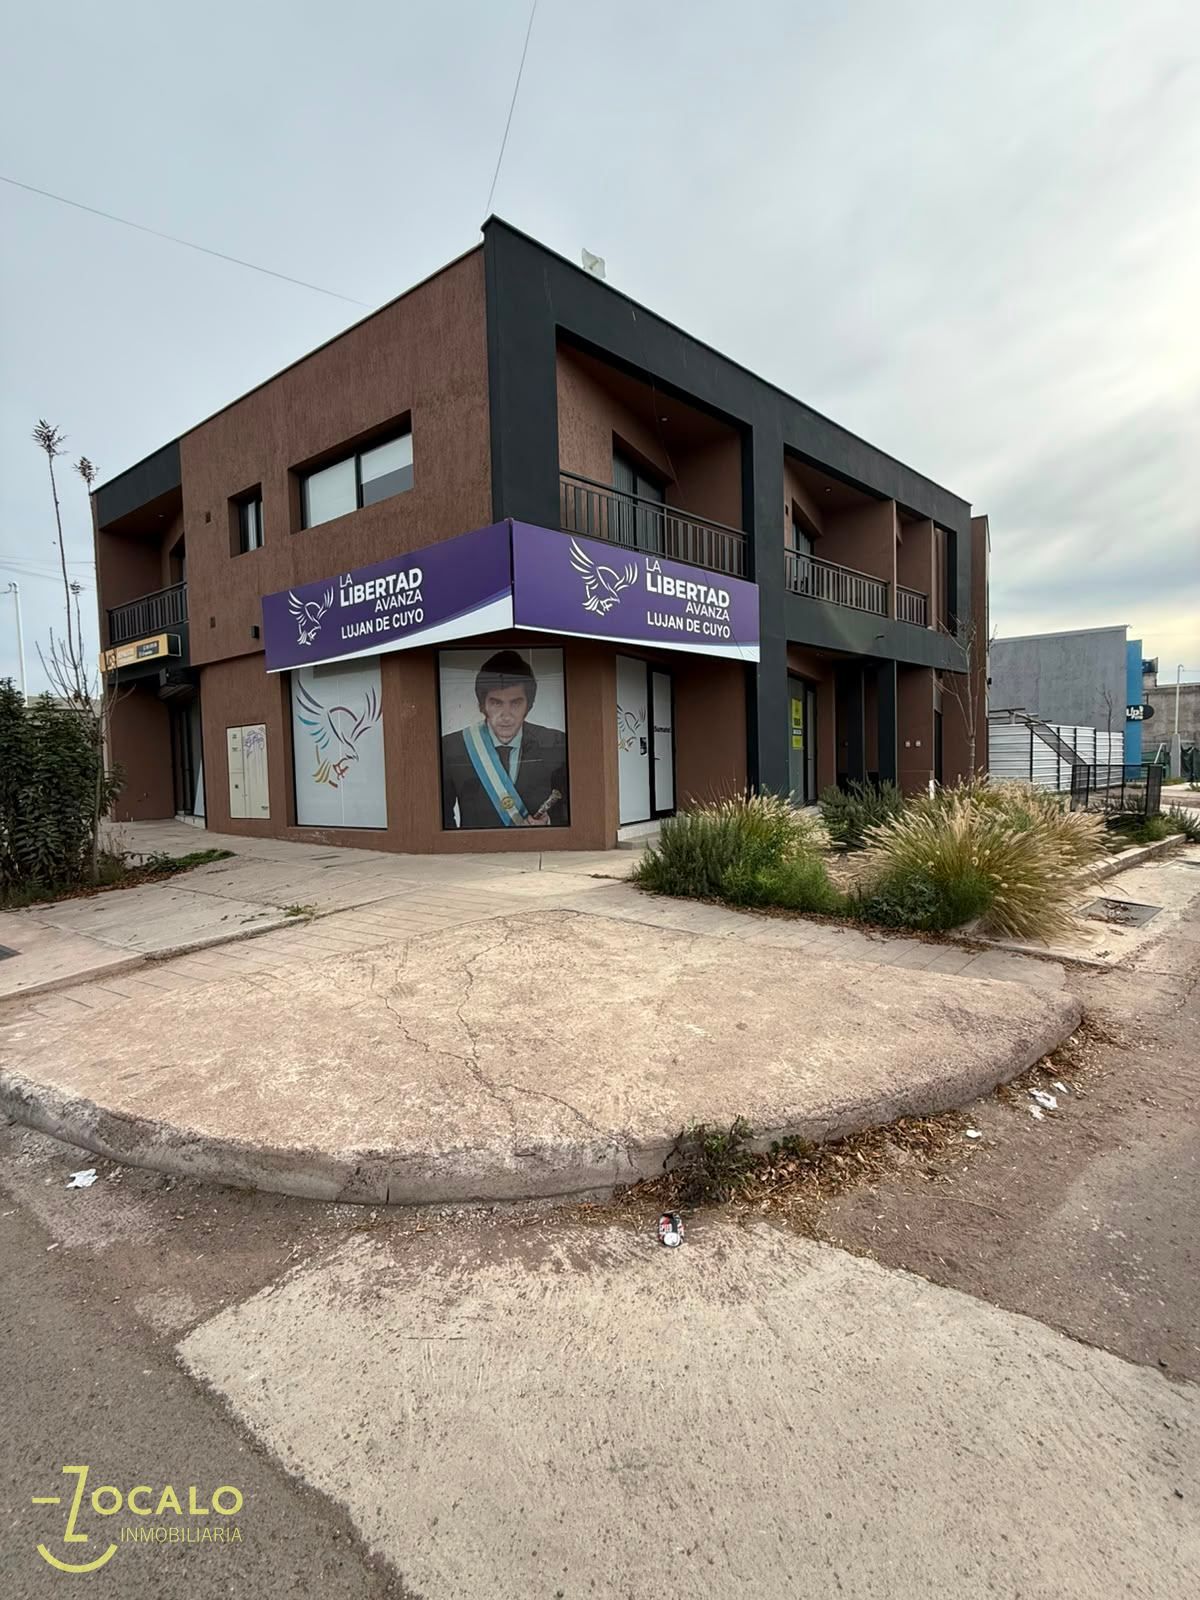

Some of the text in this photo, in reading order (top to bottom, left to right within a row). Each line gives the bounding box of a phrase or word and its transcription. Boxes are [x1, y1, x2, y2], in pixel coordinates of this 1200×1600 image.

[645, 557, 662, 573] LA
[340, 573, 353, 588] LA
[340, 568, 423, 607] LIBERTAD
[646, 573, 730, 608] LIBERTAD
[374, 591, 423, 613] AVANZA
[685, 601, 730, 621] AVANZA
[341, 608, 424, 640] LUJAN DE CUYO
[647, 611, 731, 639] LUJAN DE CUYO
